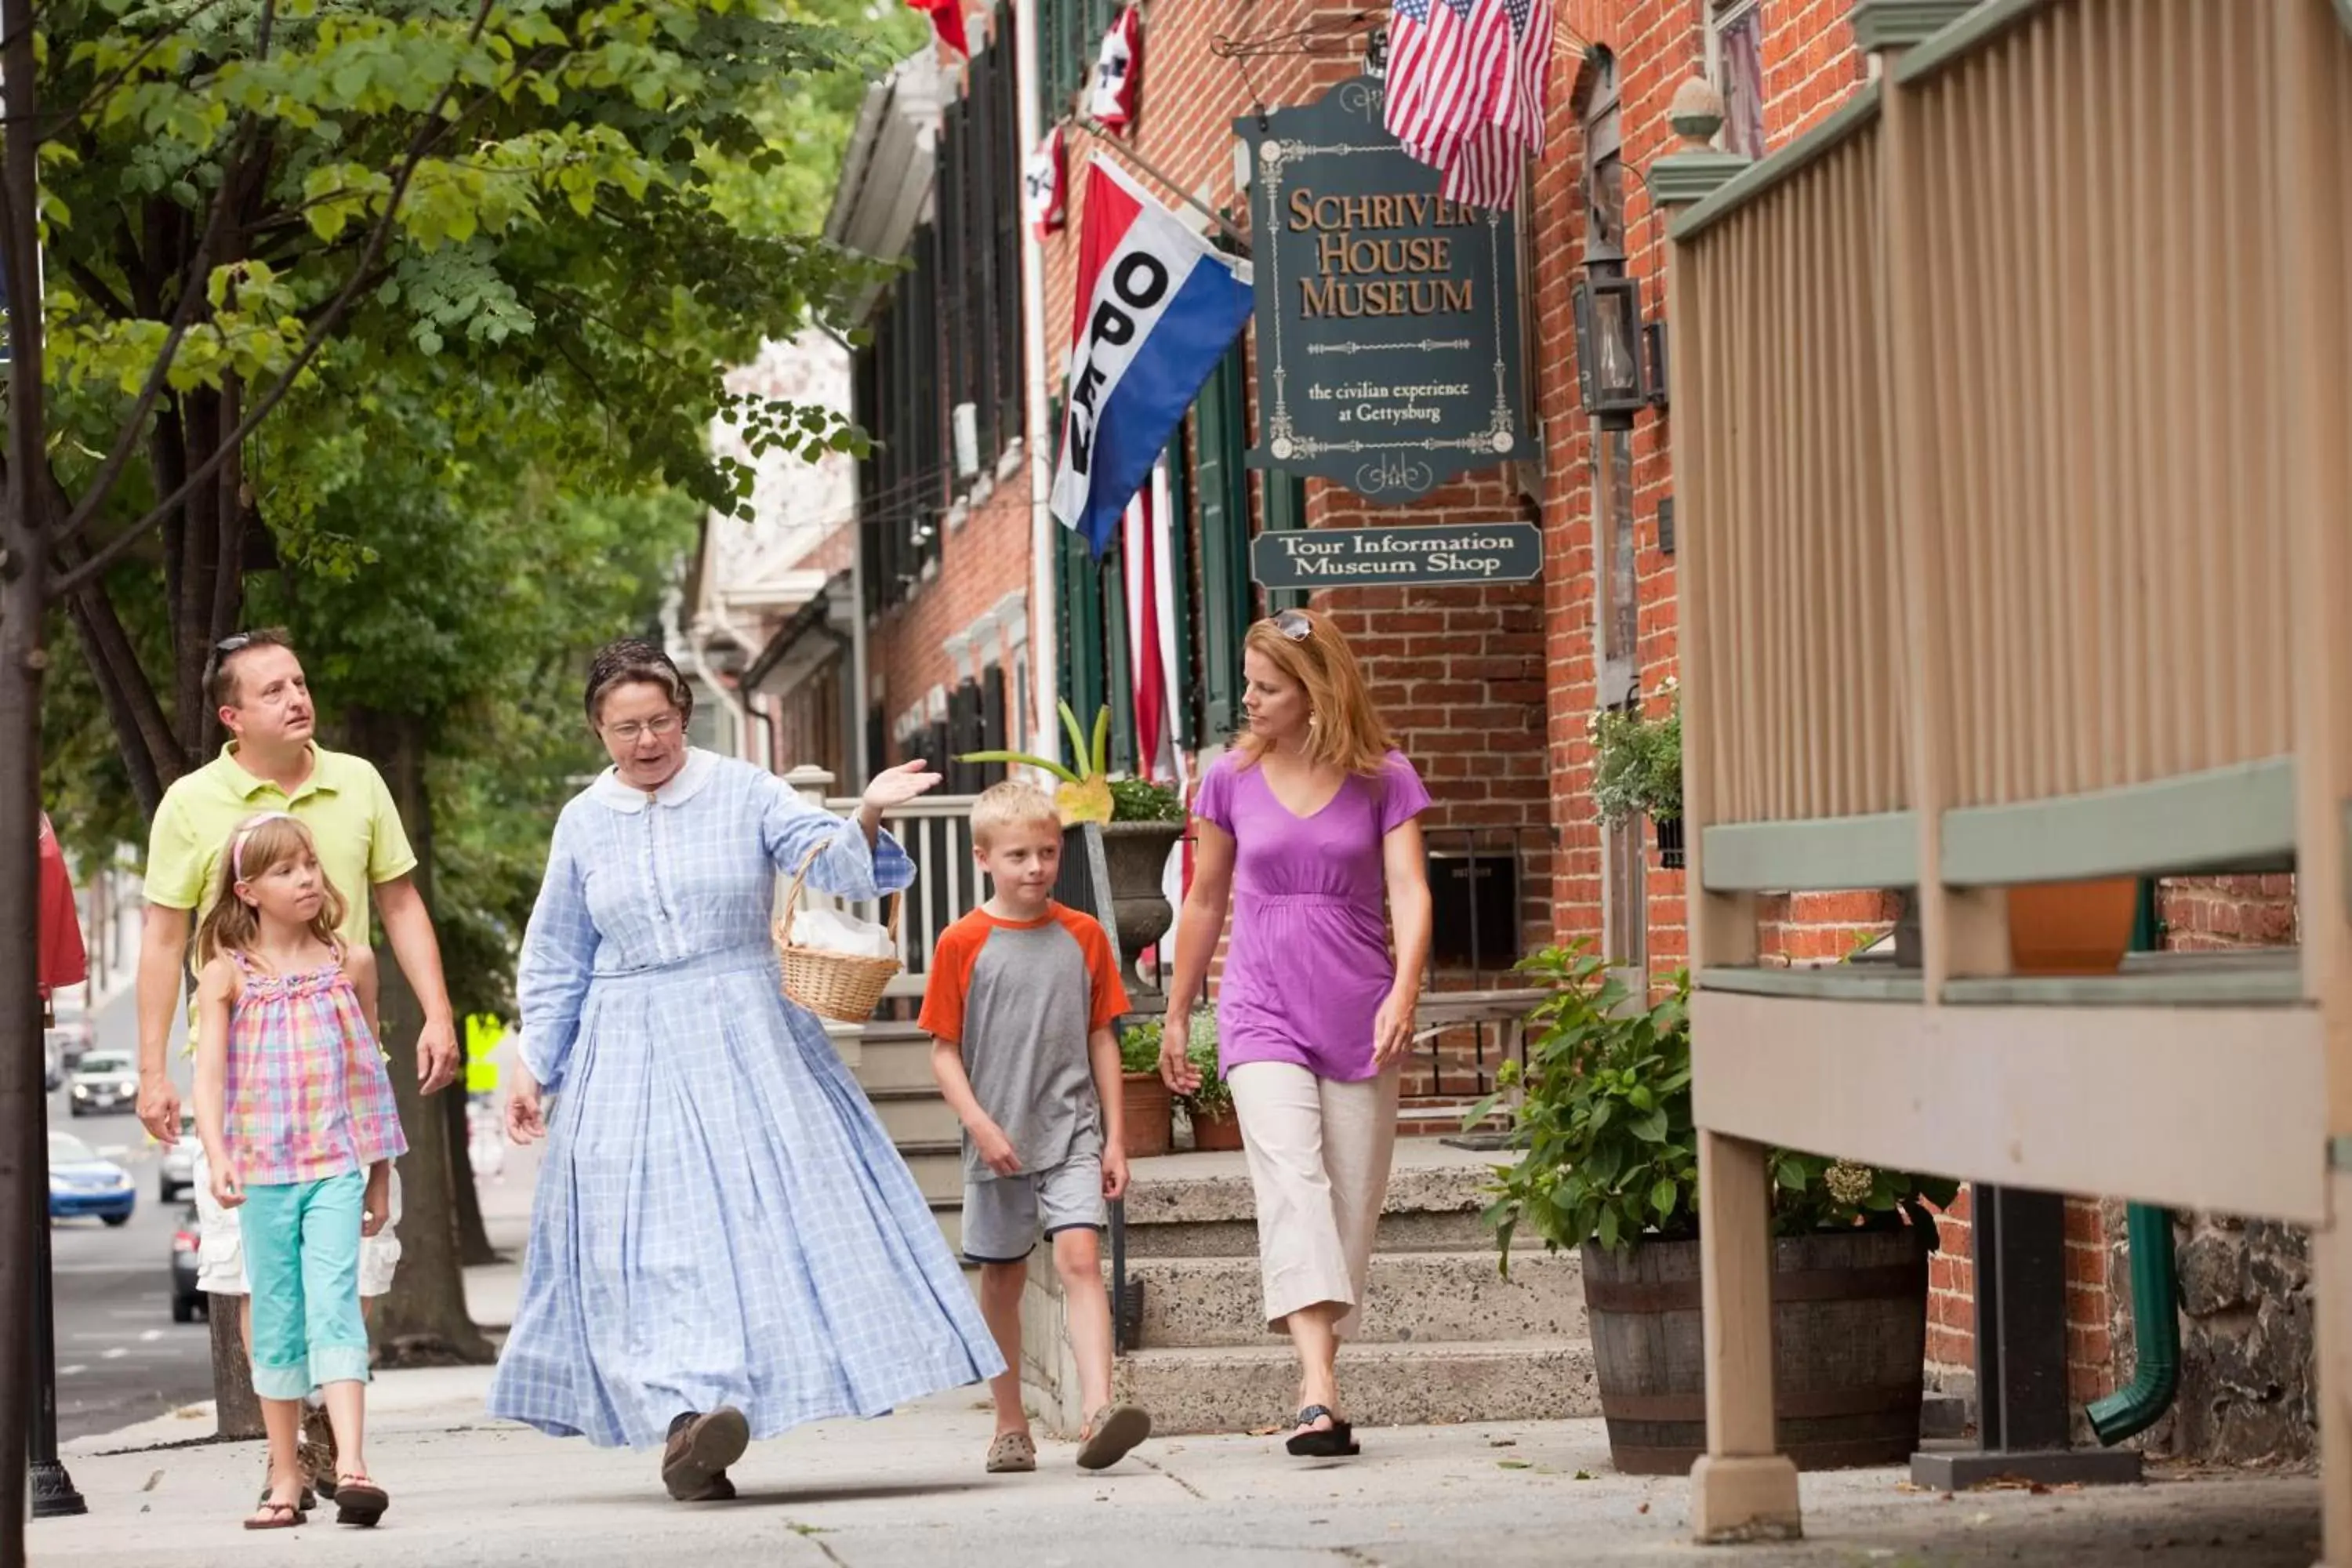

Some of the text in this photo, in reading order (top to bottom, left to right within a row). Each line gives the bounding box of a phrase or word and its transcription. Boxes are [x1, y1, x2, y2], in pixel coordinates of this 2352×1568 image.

[1319, 233, 1451, 274] HOUSE
[1300, 276, 1472, 318] MUSEUM
[1308, 379, 1468, 401] the civilian experience
[1338, 403, 1441, 426] at Gettysburg
[1278, 532, 1514, 556] Tour Information
[1294, 553, 1501, 576] Museum Shop
